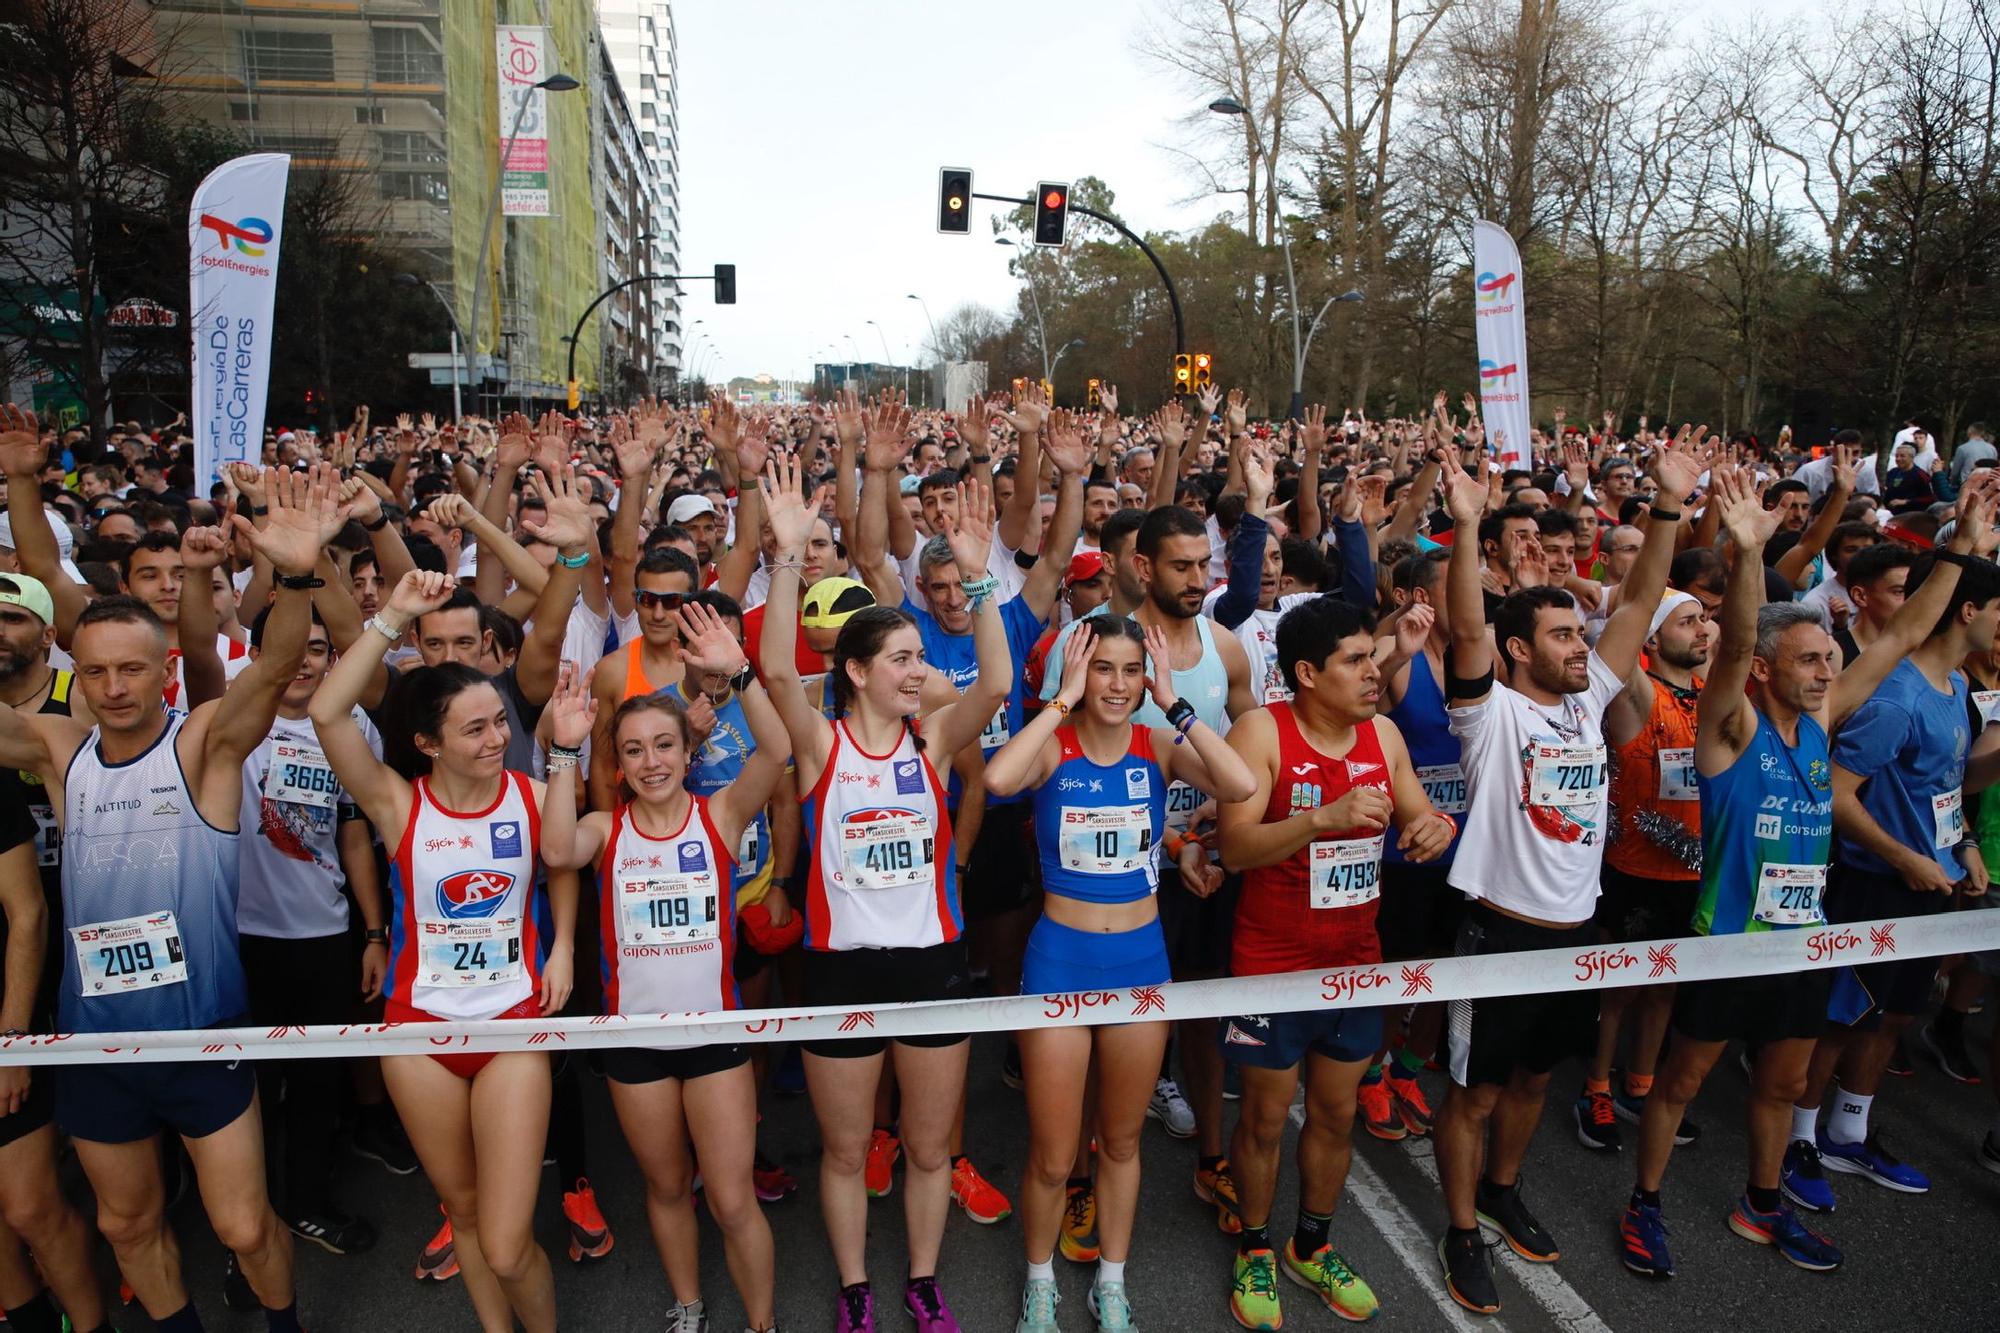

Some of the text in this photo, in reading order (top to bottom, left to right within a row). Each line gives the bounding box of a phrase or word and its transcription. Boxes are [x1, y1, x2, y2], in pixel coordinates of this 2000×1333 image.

[201, 255, 270, 276] TotalEnergies
[224, 317, 254, 461] LasCarreras
[277, 746, 297, 758] 53
[1539, 748, 1561, 758] 53
[283, 763, 337, 795] 3669
[1057, 778, 1086, 791] gijón
[1557, 764, 1594, 790] 720
[150, 786, 178, 794] VESKIN
[94, 799, 142, 815] ALTITUD
[1760, 795, 1789, 811] DC
[1936, 797, 1950, 809] 53
[1065, 812, 1086, 823] 53
[845, 829, 866, 839] 53
[1759, 821, 1778, 835] nf
[424, 837, 455, 853] gijón
[1095, 831, 1118, 858] 10
[865, 840, 913, 872] 4119
[1315, 848, 1336, 859] 53
[621, 856, 645, 870] gijón
[1327, 861, 1376, 892] 4793
[625, 881, 647, 893] 53
[1779, 885, 1815, 910] 278
[648, 897, 690, 928] 109
[79, 929, 99, 942] 53
[425, 923, 447, 935] 53
[623, 942, 715, 959] GIJÓN ATLETISMO
[1806, 928, 1862, 961] gijón
[99, 941, 155, 977] 209
[454, 942, 488, 970] 24
[1574, 947, 1638, 982] gijón
[1320, 967, 1392, 1001] gijón
